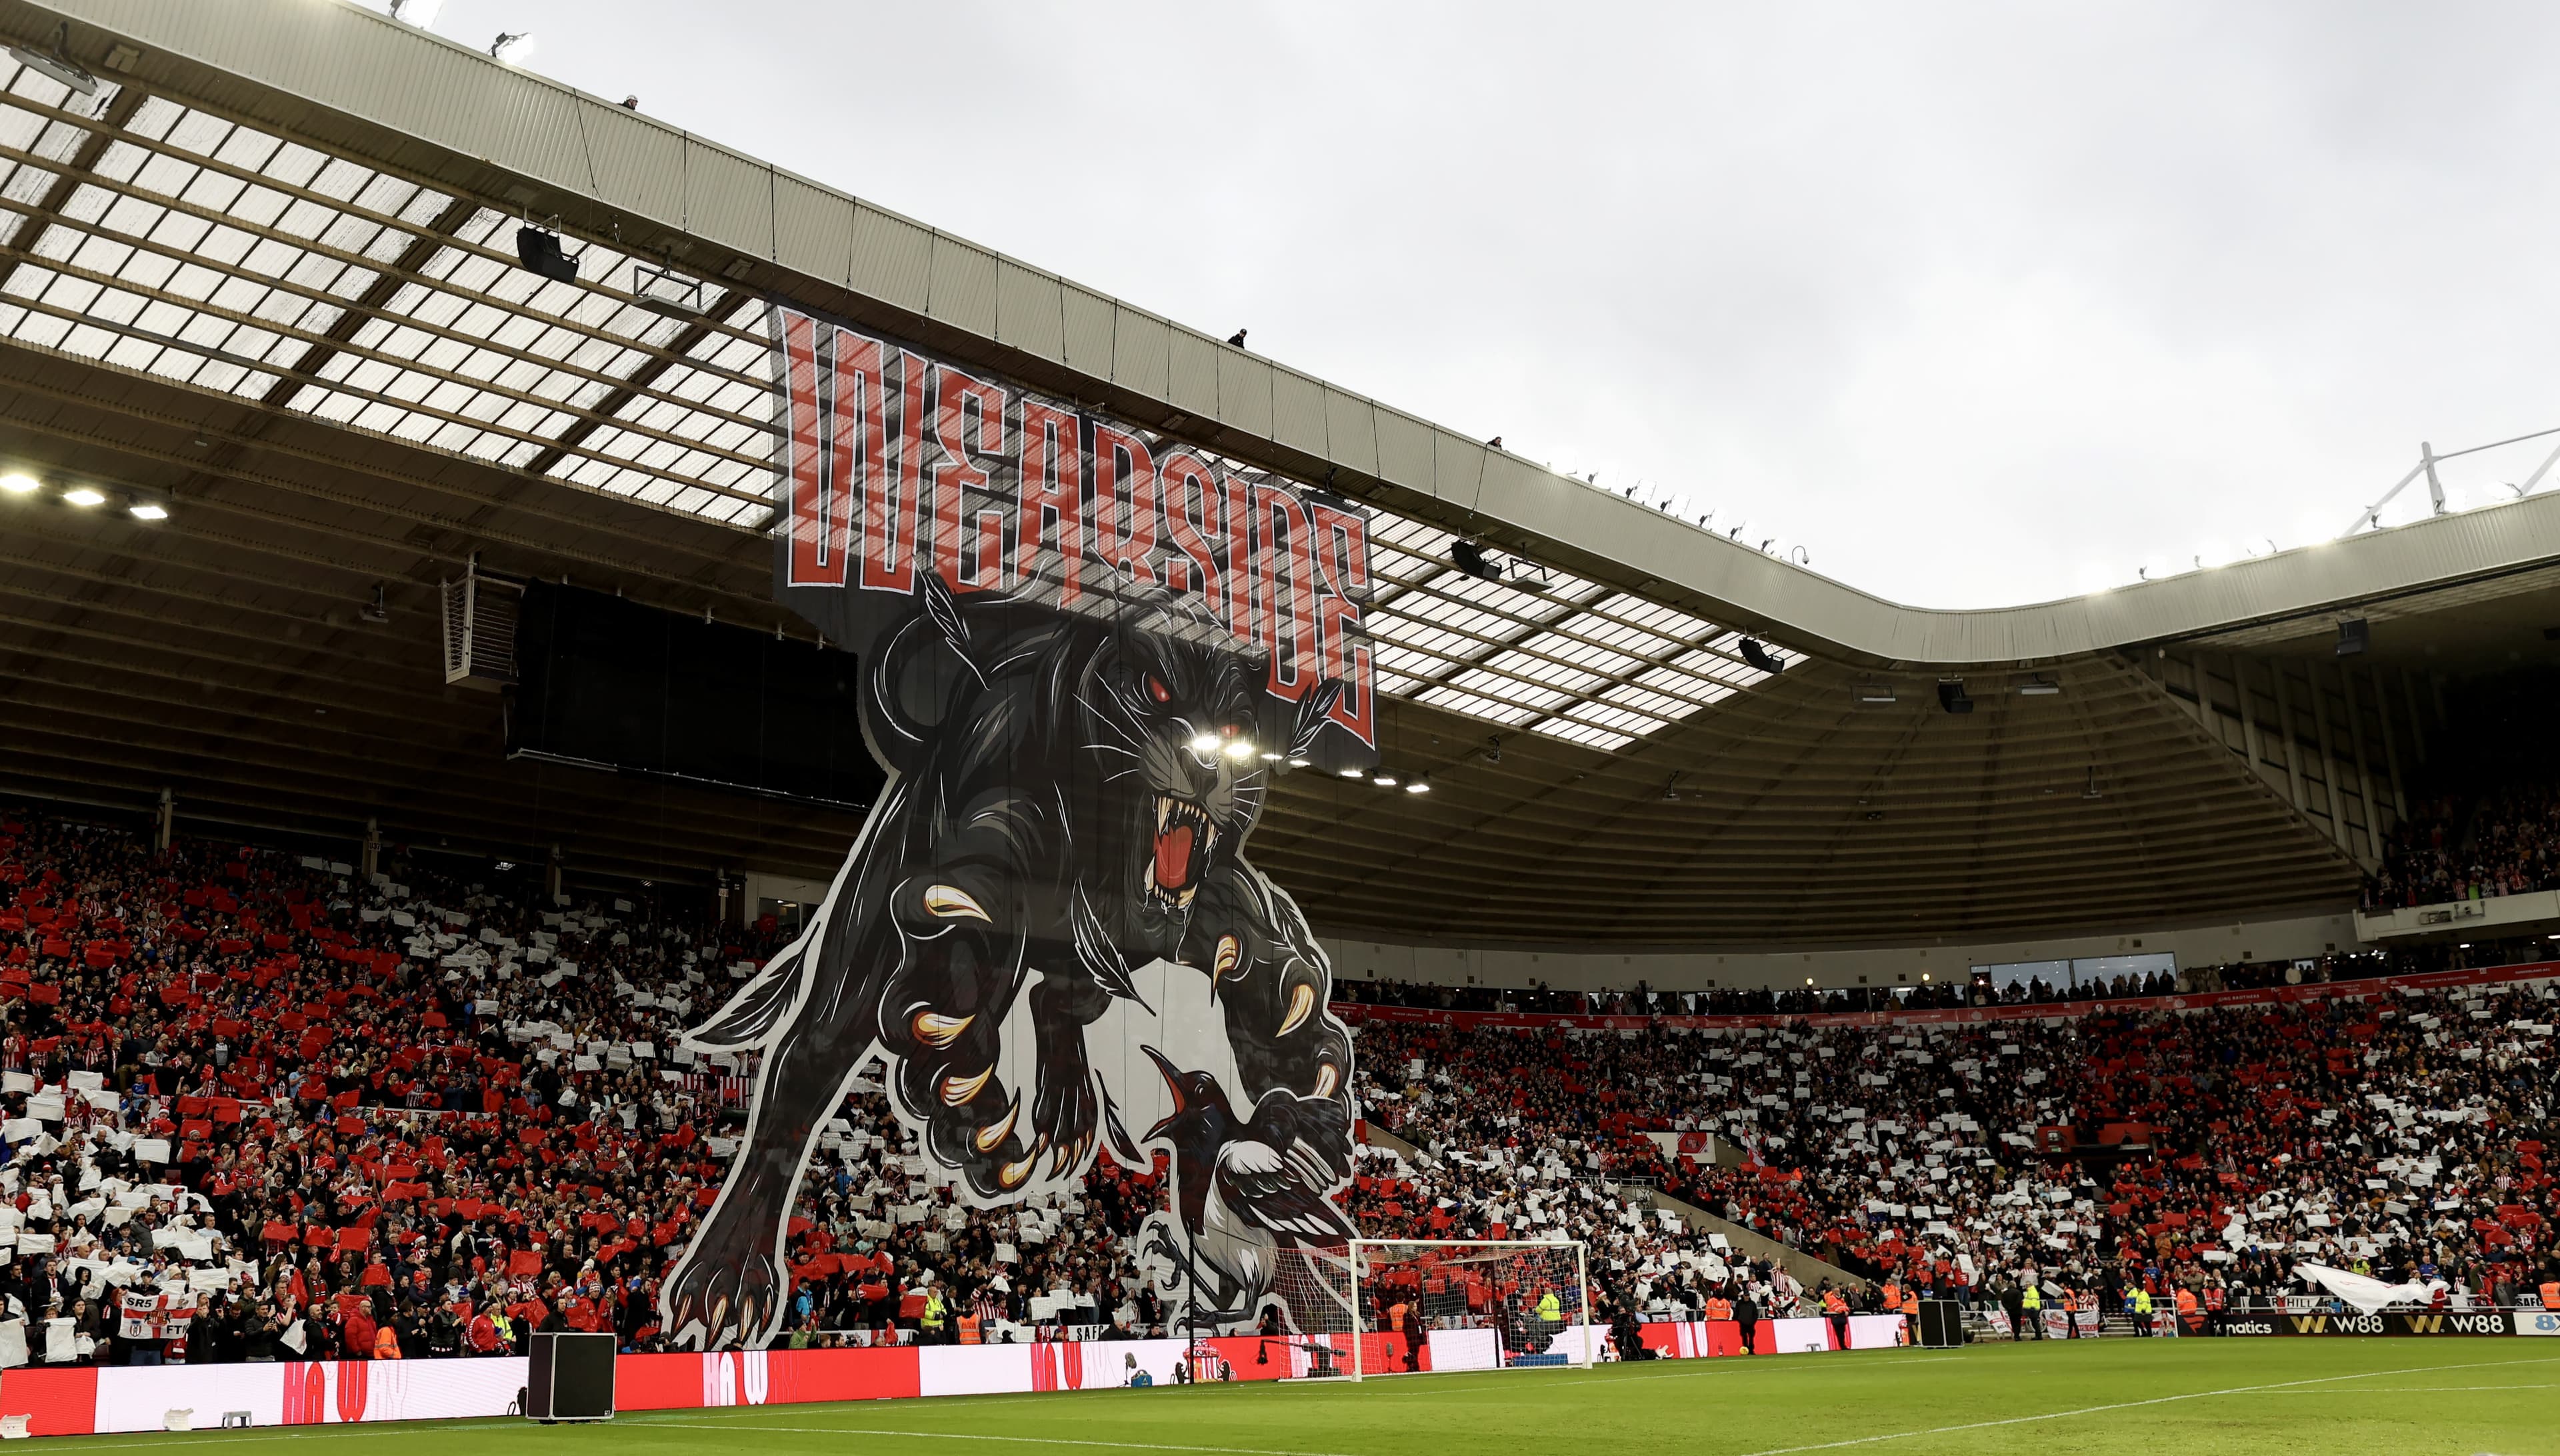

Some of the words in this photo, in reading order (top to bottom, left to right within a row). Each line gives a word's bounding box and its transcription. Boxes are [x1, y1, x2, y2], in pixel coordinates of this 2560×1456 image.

[777, 305, 1375, 751] WEARSIDE
[369, 842, 381, 850] U37
[127, 1297, 152, 1307] SR5
[2517, 1298, 2543, 1307] SAFC
[2215, 1319, 2272, 1334] natics
[2333, 1315, 2384, 1333] W88
[2449, 1315, 2505, 1333] W88
[1077, 1325, 1103, 1341] SAFC
